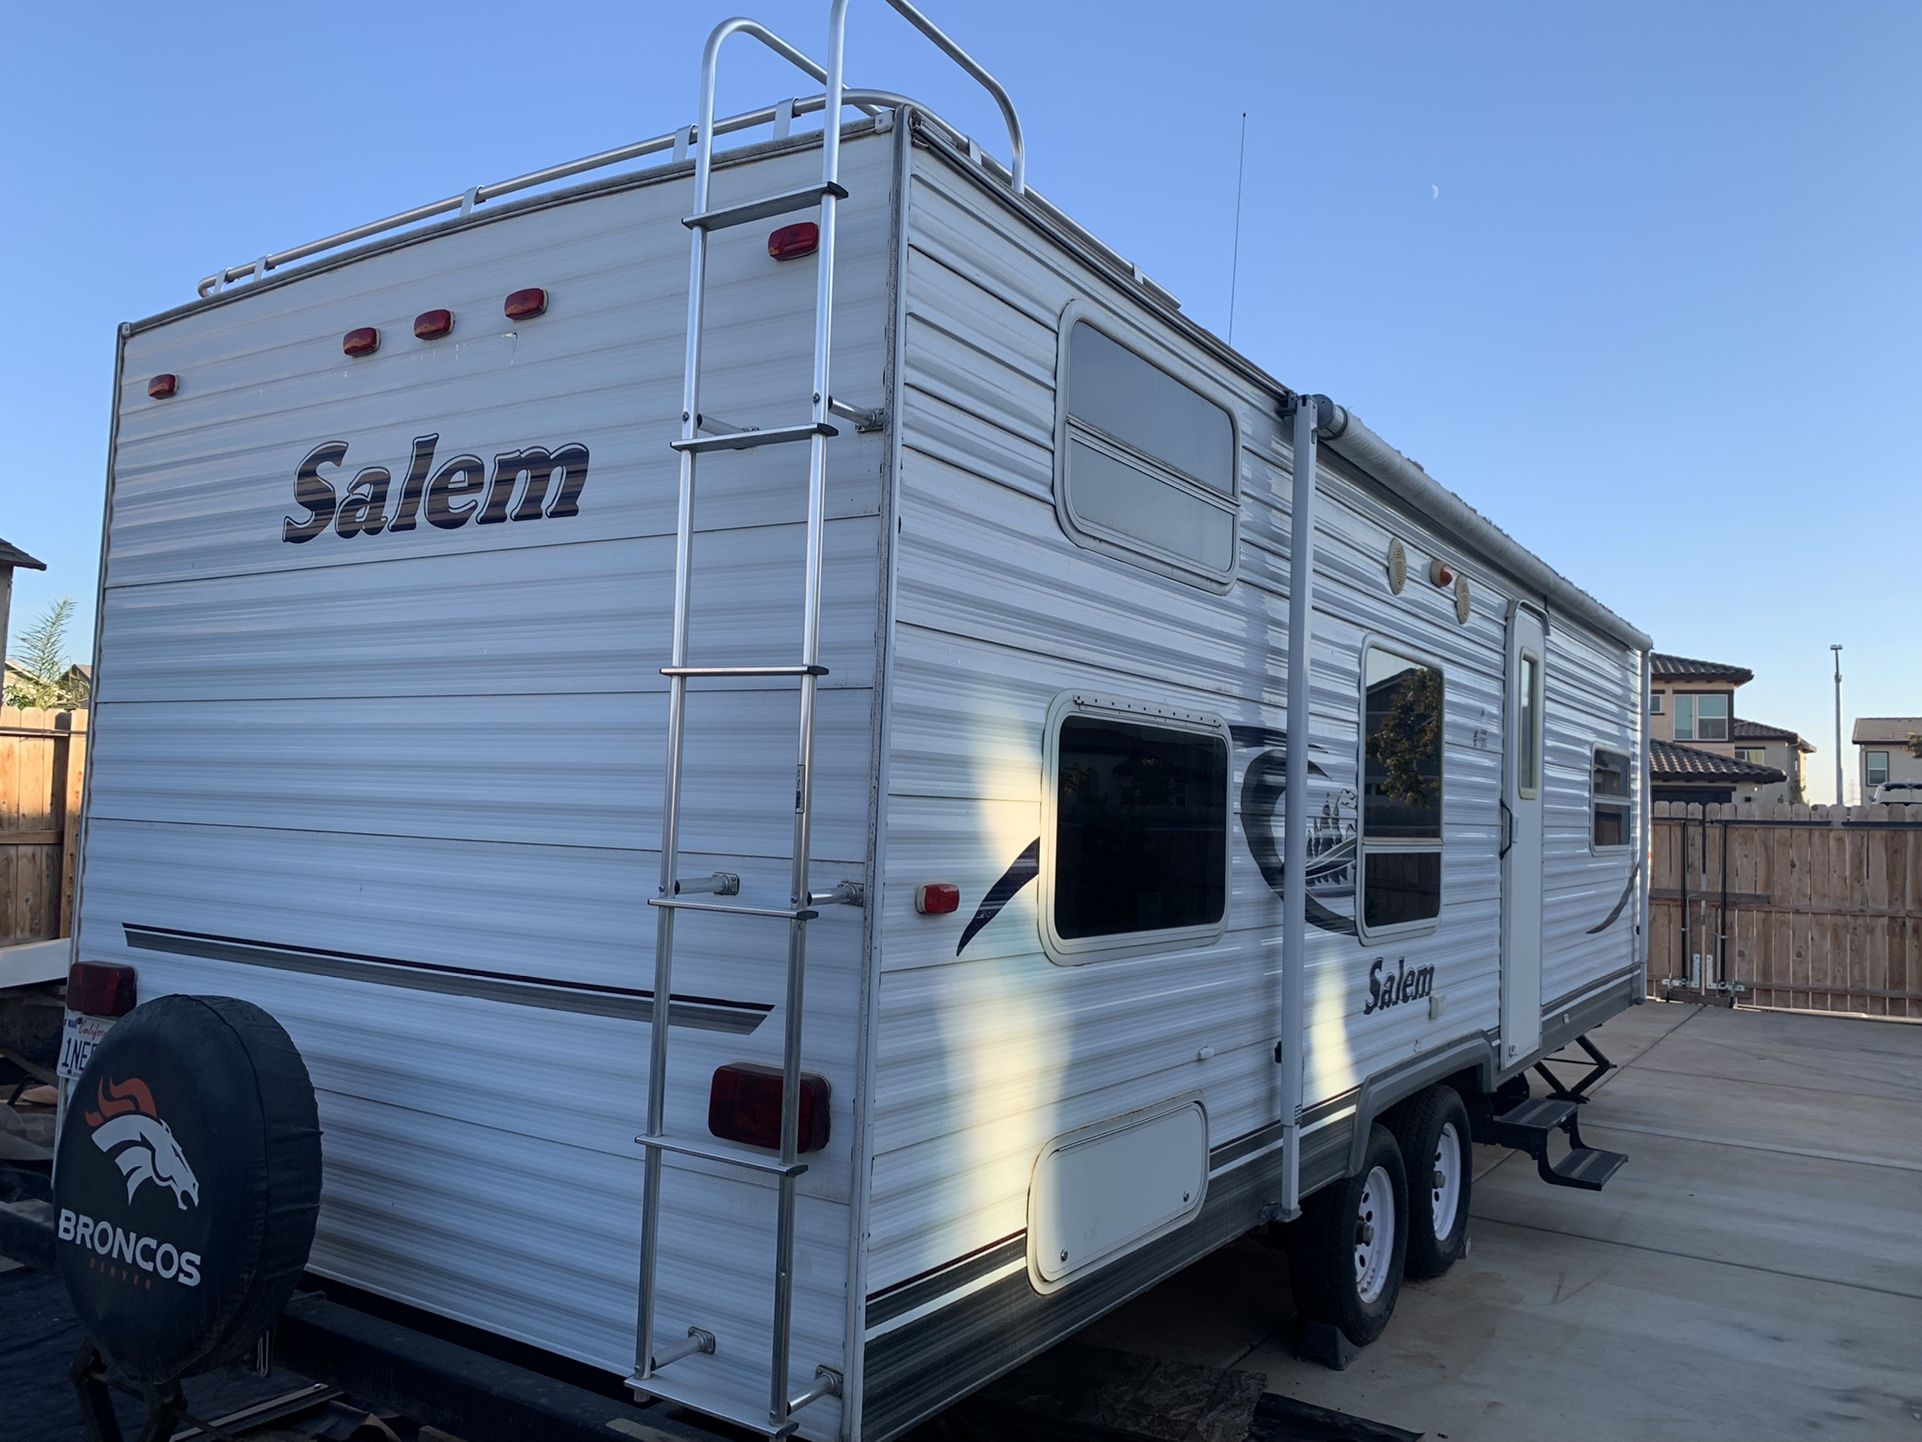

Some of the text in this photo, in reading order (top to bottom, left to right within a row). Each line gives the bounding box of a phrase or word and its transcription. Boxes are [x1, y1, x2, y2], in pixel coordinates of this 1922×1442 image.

[282, 432, 590, 544] Salem
[1363, 955, 1434, 1015] Salem
[62, 1037, 98, 1071] 1NE
[58, 1208, 201, 1287] BRONCOS
